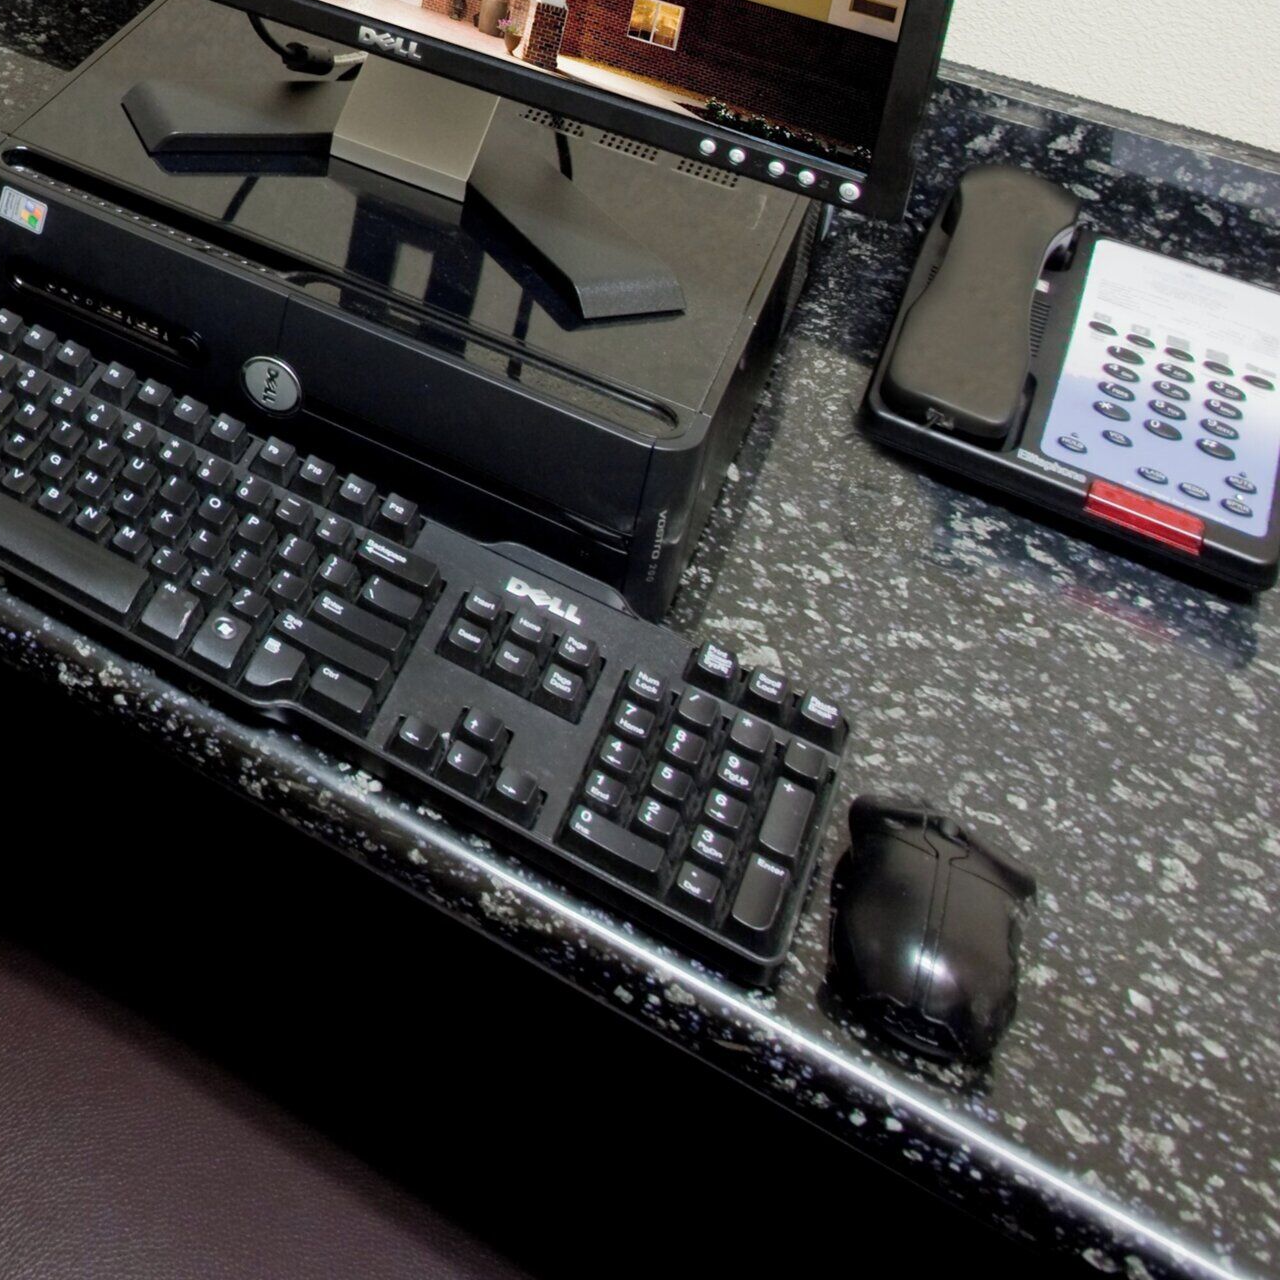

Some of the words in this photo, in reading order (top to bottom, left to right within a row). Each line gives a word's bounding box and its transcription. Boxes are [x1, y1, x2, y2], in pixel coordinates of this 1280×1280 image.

[358, 25, 422, 60] DELL
[20, 379, 29, 388] 4
[261, 367, 280, 403] DELL
[23, 403, 36, 416] R
[181, 403, 193, 413] F7
[90, 413, 100, 422] 6
[1151, 419, 1161, 428] 0
[61, 421, 72, 432] T
[13, 434, 26, 444] F
[126, 431, 136, 440] 7
[98, 440, 108, 451] Y
[50, 453, 62, 467] G
[163, 449, 172, 459] 8
[132, 458, 145, 470] U
[307, 463, 323, 476] F10
[13, 468, 25, 479] V
[85, 471, 98, 484] H
[201, 468, 210, 477] 9
[47, 487, 60, 498] B
[347, 482, 362, 495] F11
[122, 492, 135, 502] J
[209, 497, 222, 509] O
[84, 506, 98, 519] N
[389, 502, 405, 516] F12
[160, 510, 174, 523] K
[247, 515, 260, 526] P
[122, 526, 137, 539] M
[199, 530, 208, 542] L
[651, 509, 668, 560] VOSTRO
[164, 582, 177, 594] Alt
[473, 595, 496, 610] Insert
[505, 576, 582, 626] DELL
[519, 617, 542, 633] Home
[458, 628, 481, 644] Delete
[564, 643, 576, 654] Up
[568, 636, 588, 651] Page
[322, 666, 340, 680] Ctrl
[554, 671, 573, 686] Page
[638, 671, 661, 687] Num
[549, 678, 572, 694] Down
[635, 679, 658, 695] Lock
[756, 680, 779, 696] Lock
[626, 703, 637, 716] 7
[619, 718, 645, 736] Home
[675, 730, 688, 743] 8
[610, 741, 622, 753] 4
[727, 755, 741, 769] 9
[661, 765, 674, 780] 5
[723, 768, 750, 787] PgUp
[597, 775, 605, 786] 1
[590, 786, 610, 801] End
[715, 793, 728, 807] 6
[647, 801, 661, 815] 2
[580, 809, 593, 823] 0
[701, 829, 714, 843] 3
[697, 841, 723, 859] PgDn
[757, 857, 785, 877] Enter
[683, 880, 701, 895] Del
